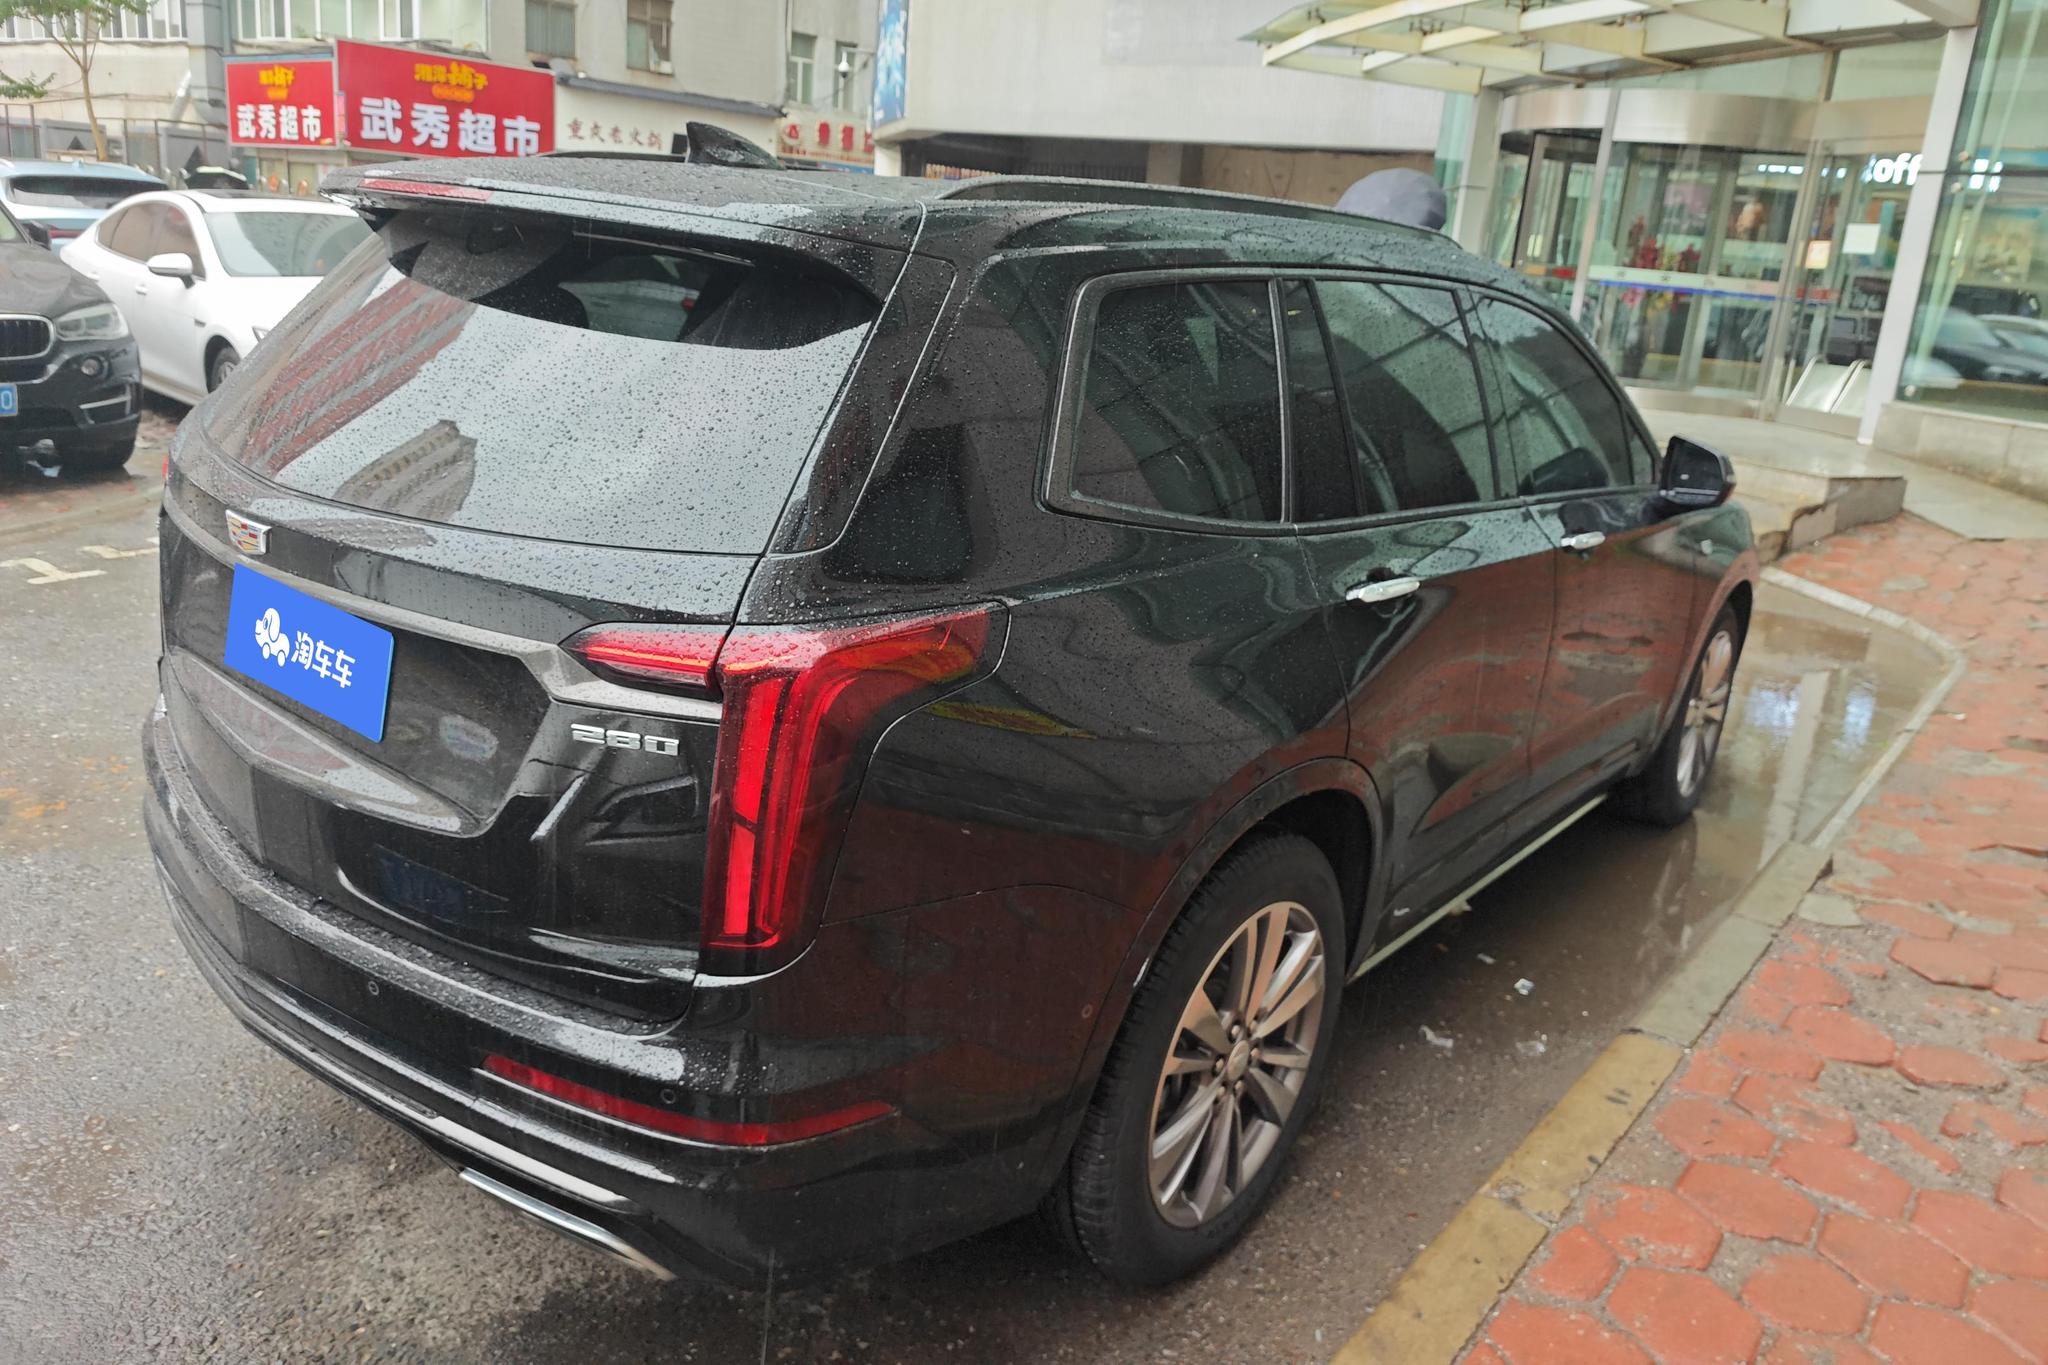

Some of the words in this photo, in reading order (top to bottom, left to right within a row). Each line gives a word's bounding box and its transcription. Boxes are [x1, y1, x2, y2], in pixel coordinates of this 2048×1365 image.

[236, 103, 322, 142] 武秀超市
[360, 96, 541, 156] 武秀超市
[571, 723, 679, 756] 280
